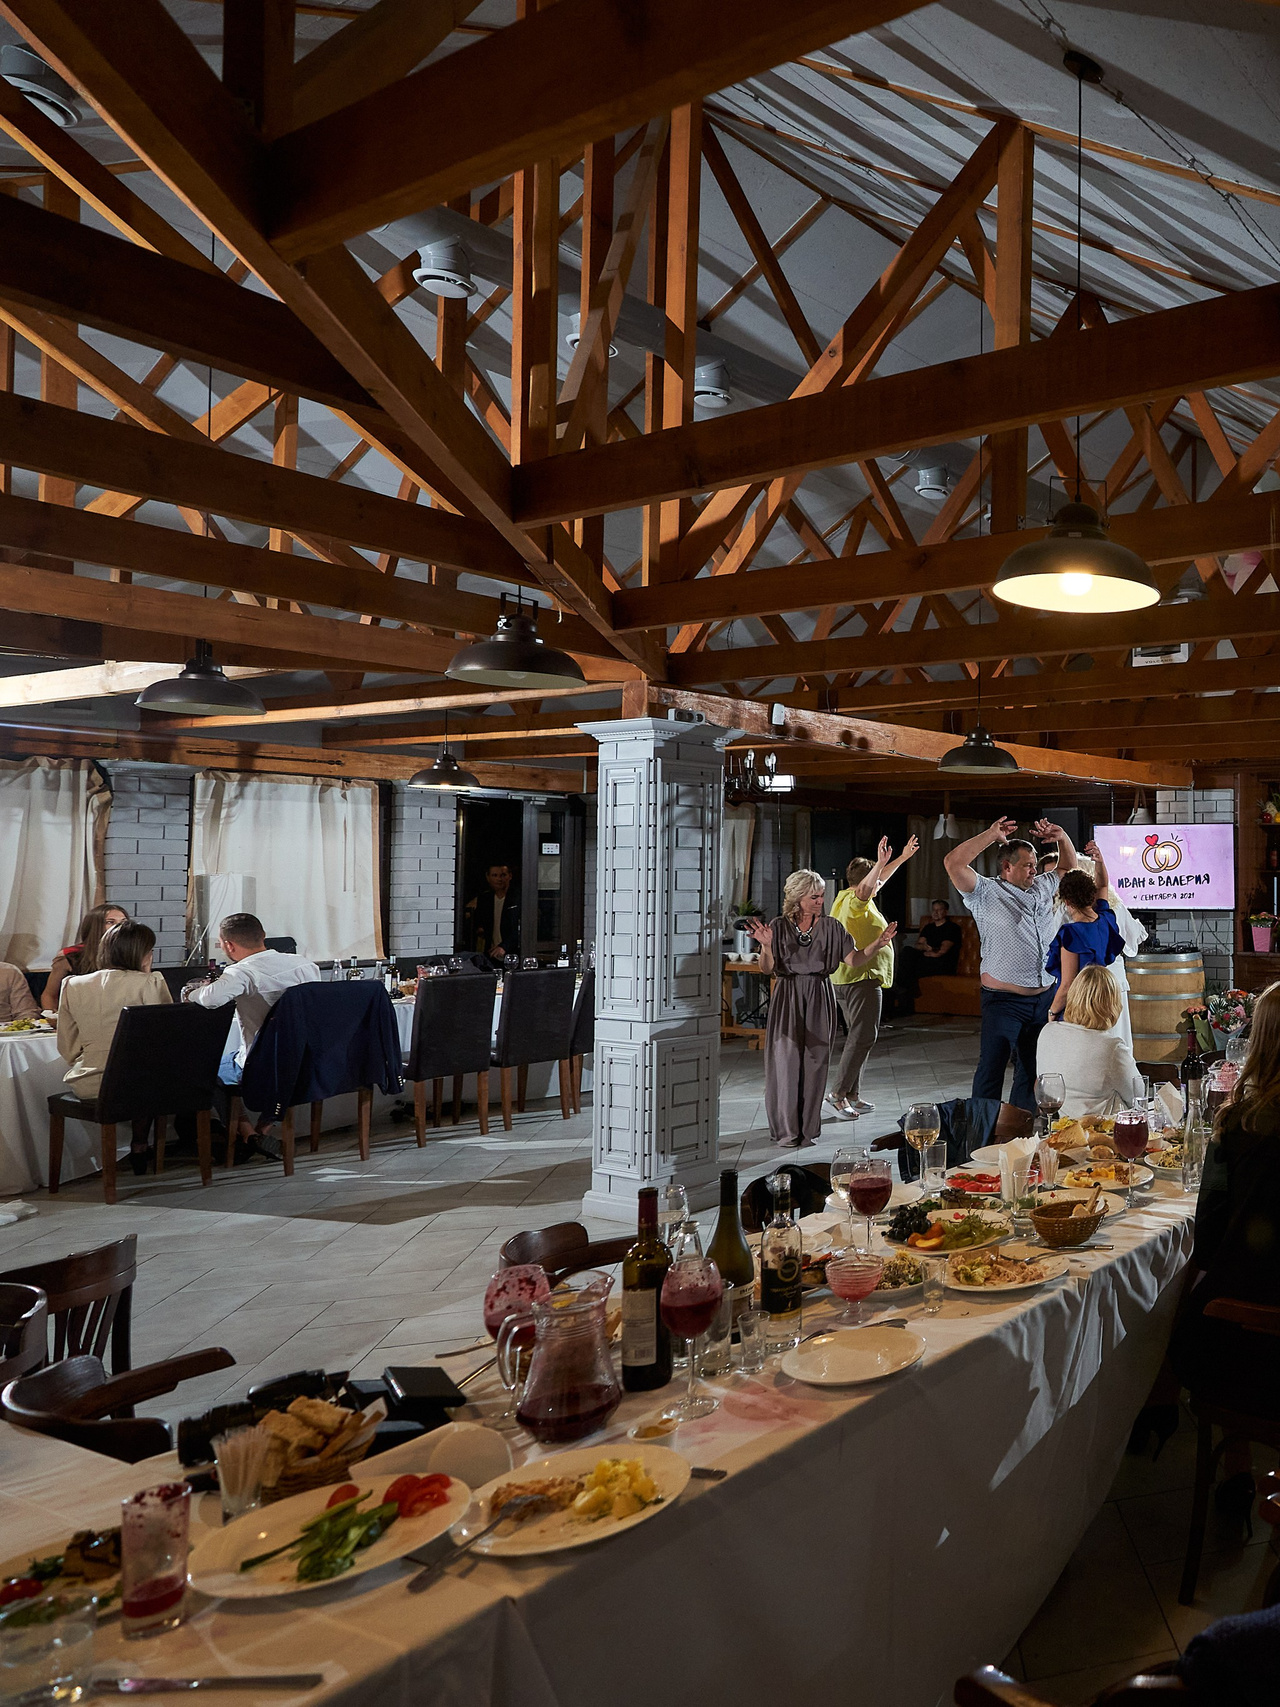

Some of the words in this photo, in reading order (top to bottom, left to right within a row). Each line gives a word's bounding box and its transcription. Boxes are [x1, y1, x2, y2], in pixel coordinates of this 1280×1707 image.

[1117, 877, 1146, 889] ИВАН
[1148, 878, 1155, 886] &
[1158, 873, 1210, 887] ВАЛЕРИЯ
[1140, 892, 1177, 901] СЕНТЯБРЯ
[1180, 892, 1195, 900] 2021
